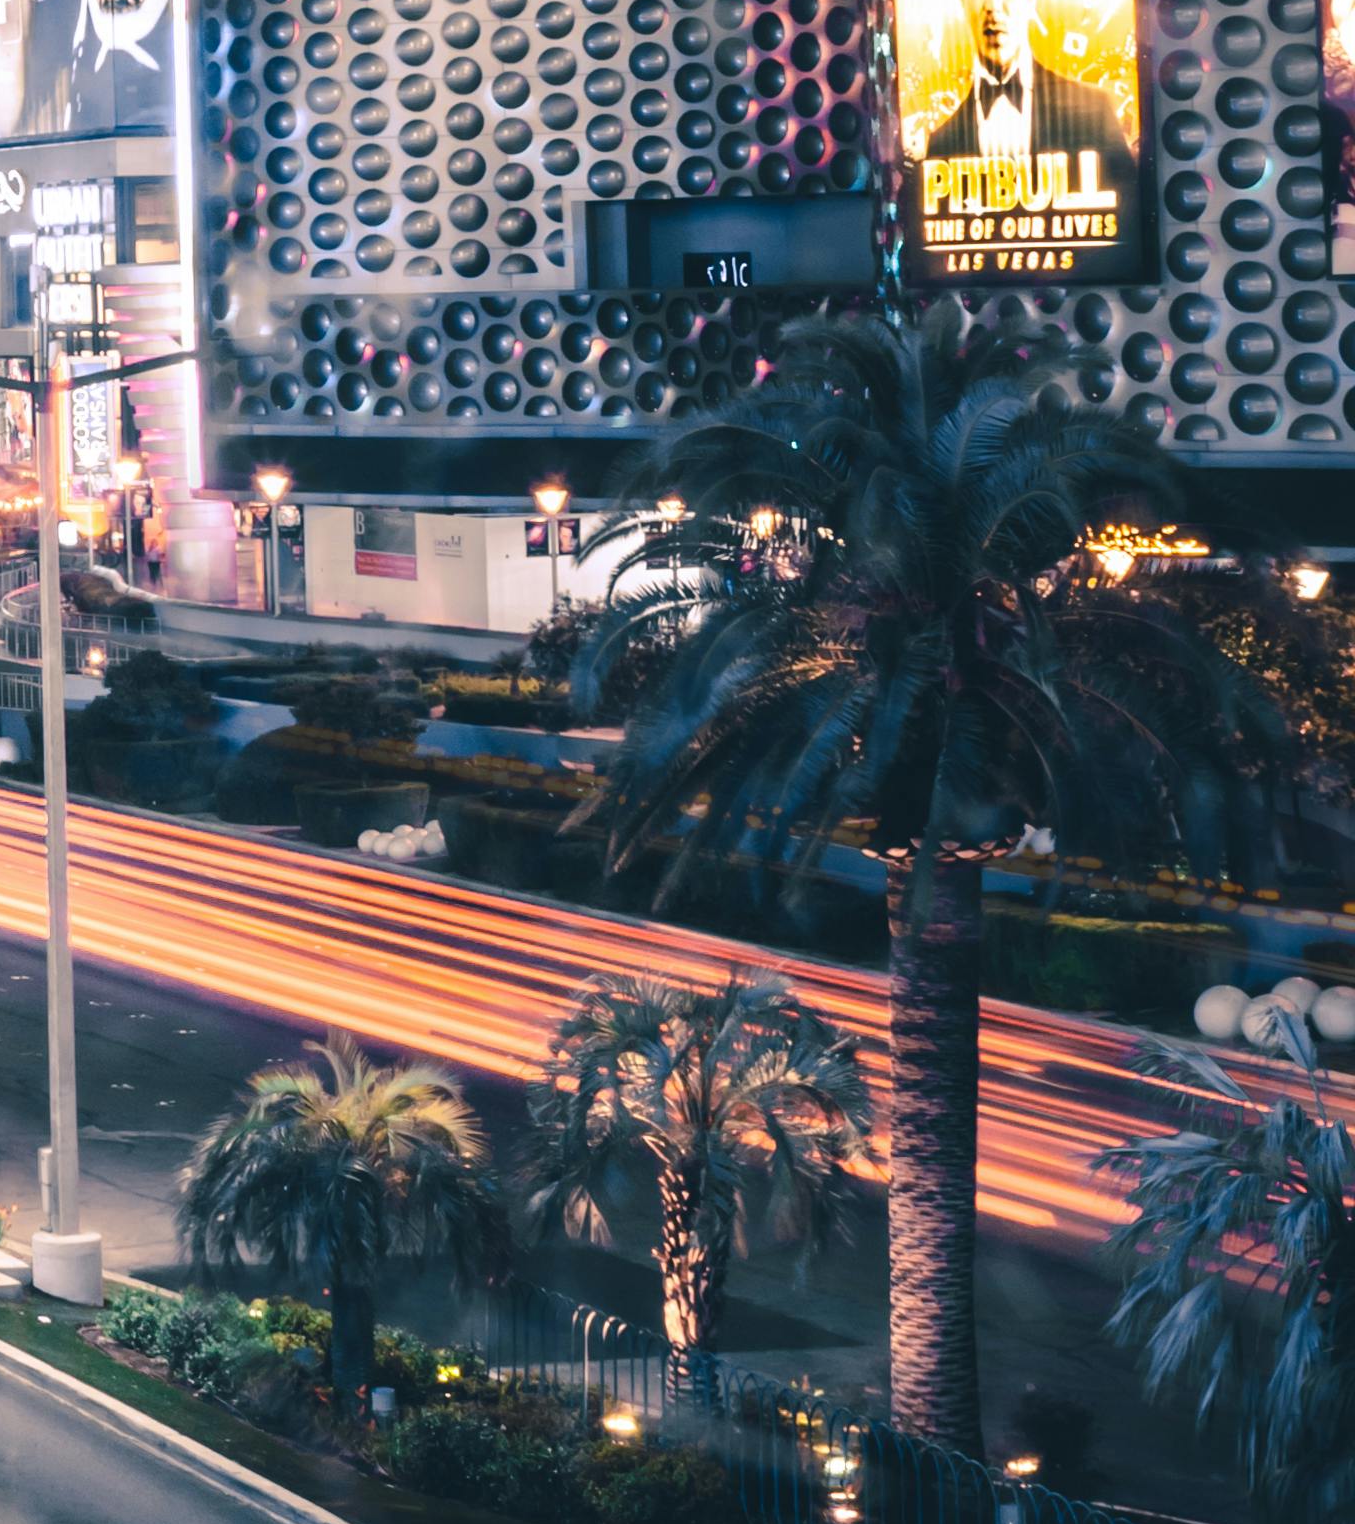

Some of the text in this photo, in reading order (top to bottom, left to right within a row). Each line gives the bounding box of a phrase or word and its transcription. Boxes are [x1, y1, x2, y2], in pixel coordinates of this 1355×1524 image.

[922, 150, 1117, 216] PITBULL
[969, 218, 995, 240] OF
[1000, 216, 1045, 240] OUR
[1051, 214, 1118, 239] LIVES
[946, 250, 1075, 273] LAS VEGAS
[71, 382, 90, 451] GORDO
